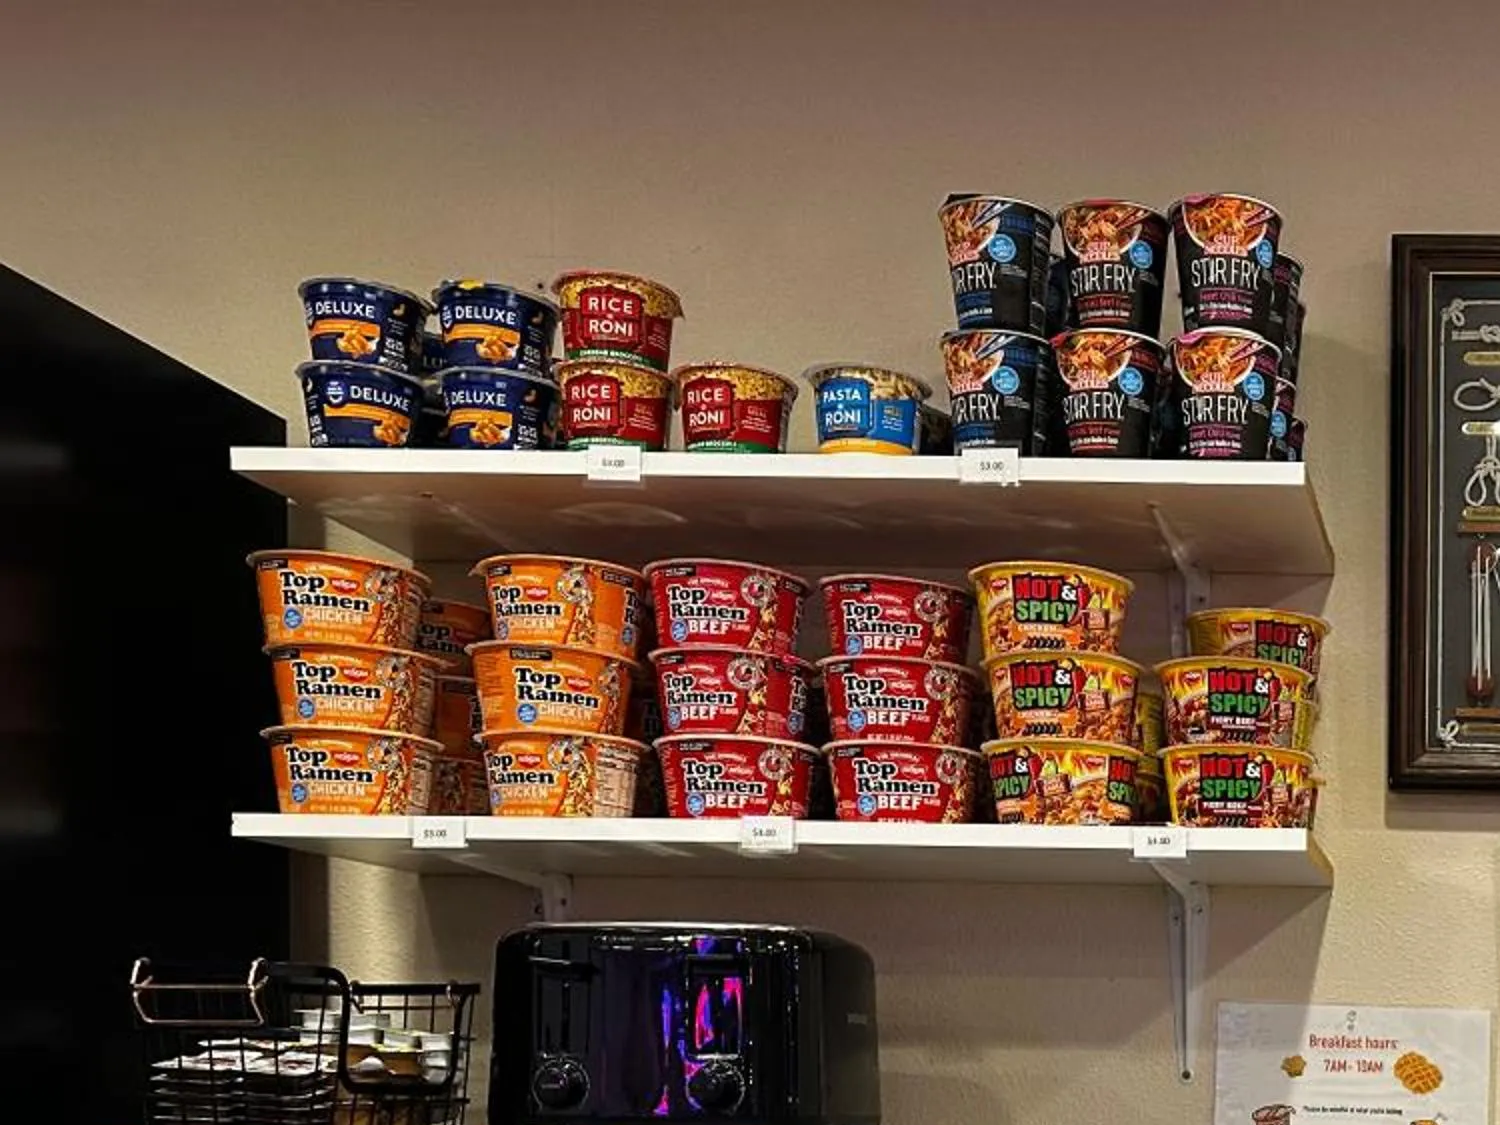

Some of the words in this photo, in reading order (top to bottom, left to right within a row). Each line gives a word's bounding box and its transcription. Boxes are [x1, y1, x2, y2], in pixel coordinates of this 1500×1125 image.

[968, 262, 997, 291] FRY
[1071, 265, 1100, 296] STIR
[1103, 263, 1136, 292] FRY
[1191, 257, 1230, 287] STIR
[1231, 258, 1261, 290] FRY
[315, 301, 375, 319] DELUXE
[588, 297, 633, 314] RICE
[455, 305, 517, 325] DELUXE
[589, 320, 633, 336] RONI
[350, 385, 410, 412] DELUXE
[451, 390, 507, 407] DELUXE
[571, 385, 611, 400] RICE
[687, 387, 725, 402] RICE
[822, 388, 862, 403] PASTA
[573, 407, 611, 423] RONI
[970, 394, 1000, 422] FRY
[1063, 394, 1090, 424] STIR
[1092, 392, 1125, 421] FRY
[1182, 397, 1215, 425] STIR
[1218, 395, 1249, 425] FRY
[689, 412, 725, 426] RONI
[825, 410, 861, 426] RONI
[280, 571, 325, 592] Top
[1015, 577, 1062, 599] HOT
[1061, 585, 1077, 601] &
[282, 589, 370, 612] Ramen
[494, 585, 520, 602] Top
[668, 586, 706, 603] Top
[496, 602, 561, 616] Ramen
[671, 602, 745, 619] Ramen
[844, 602, 880, 620] Top
[1016, 601, 1077, 621] SPICY
[689, 620, 731, 634] BEEF
[846, 618, 920, 636] Ramen
[1257, 622, 1299, 645] HOT
[1298, 632, 1307, 646] &
[863, 636, 905, 650] BEEF
[292, 662, 336, 682] Top
[515, 667, 560, 686] Top
[1012, 665, 1055, 687] HOT
[1054, 669, 1071, 685] &
[296, 680, 381, 699] Ramen
[664, 673, 693, 690] Top
[844, 676, 884, 694] Top
[1210, 671, 1256, 692] HOT
[1255, 678, 1269, 694] &
[518, 685, 599, 708] Ramen
[666, 690, 735, 704] Ramen
[848, 694, 925, 711] Ramen
[1014, 687, 1072, 708] SPICY
[1211, 693, 1269, 715] SPICY
[539, 704, 593, 721] CHICKEN
[681, 705, 718, 720] BEEF
[867, 711, 911, 726] BEEF
[286, 747, 327, 766] Top
[290, 765, 373, 782] Ramen
[489, 769, 555, 784] Ramen
[683, 760, 722, 778] Top
[854, 760, 896, 778] Top
[1201, 758, 1247, 777] HOT
[1246, 762, 1260, 778] &
[309, 782, 365, 796] CHICKEN
[686, 777, 763, 794] Ramen
[858, 777, 936, 795] Ramen
[1202, 779, 1260, 799] SPICY
[705, 794, 749, 809] BEEF
[878, 796, 922, 811] BEEF
[1309, 1034, 1362, 1049] Breakfast
